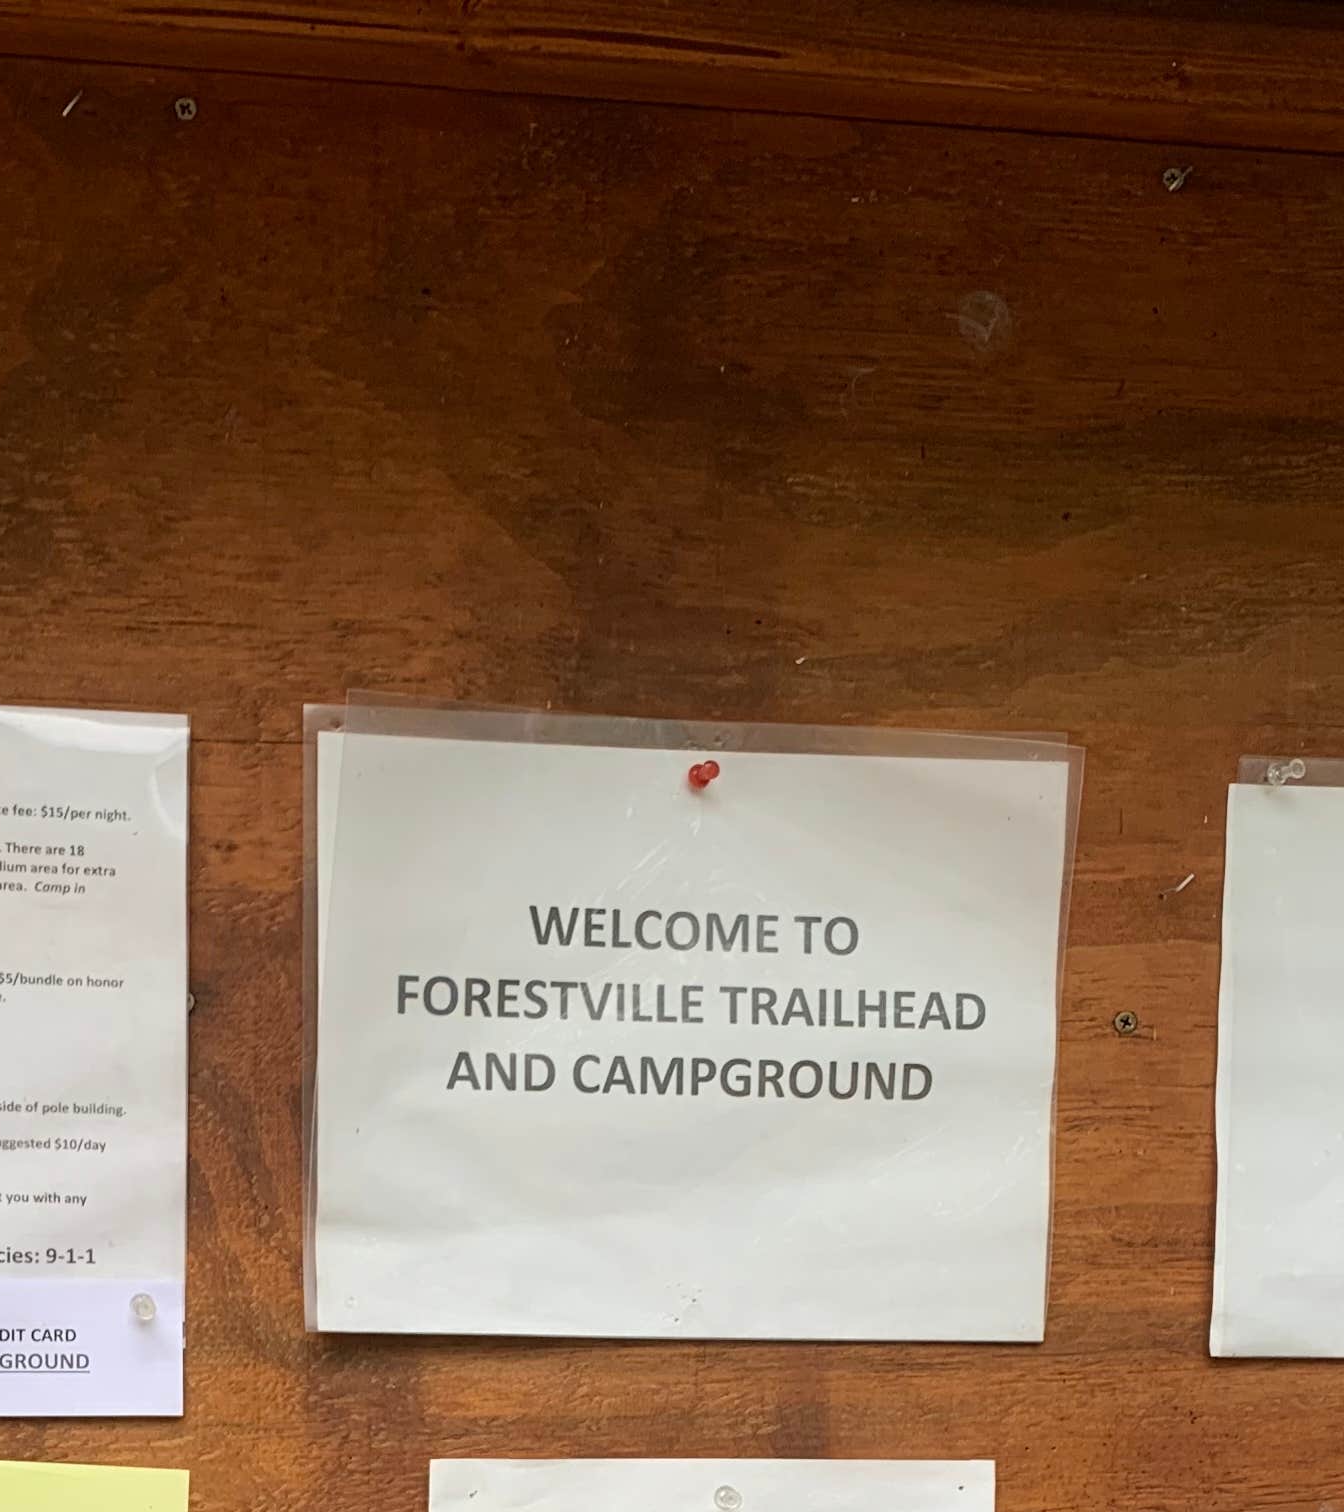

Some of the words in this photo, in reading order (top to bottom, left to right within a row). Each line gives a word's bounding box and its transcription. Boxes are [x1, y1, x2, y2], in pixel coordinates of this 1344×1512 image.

[12, 802, 37, 818] fee:
[40, 804, 92, 822] $15/per
[94, 807, 130, 824] night.
[528, 904, 779, 954] WELCOME
[793, 915, 859, 957] TO
[397, 974, 704, 1024] FORESTVILLE
[719, 985, 986, 1032] TRAILHEAD
[445, 1050, 556, 1093] AND
[572, 1053, 933, 1102] CAMPGROUND
[45, 1247, 96, 1265] 9-1-1
[30, 1327, 77, 1343] CARD
